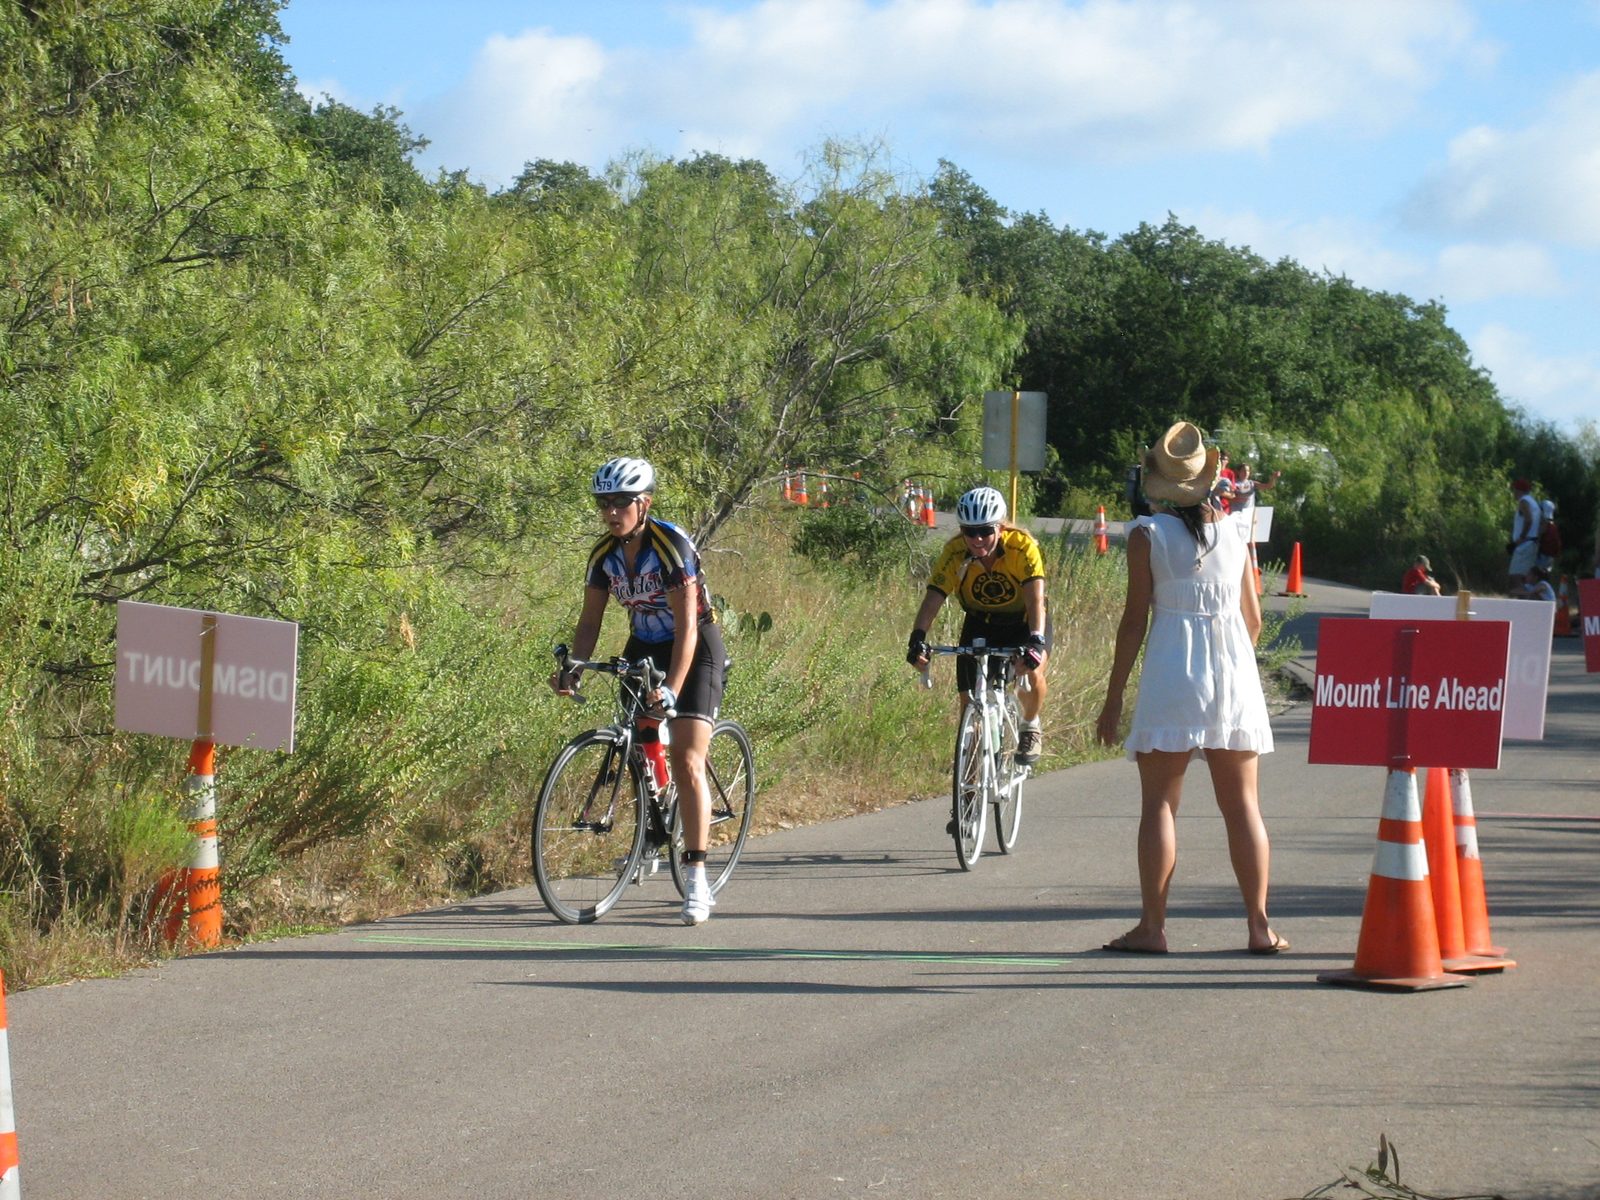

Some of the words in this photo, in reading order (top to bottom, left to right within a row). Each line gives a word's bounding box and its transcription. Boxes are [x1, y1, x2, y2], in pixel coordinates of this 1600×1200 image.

[597, 481, 612, 491] 579
[1316, 675, 1381, 708] Mount
[1386, 677, 1430, 709] Line
[1434, 677, 1504, 712] Ahead
